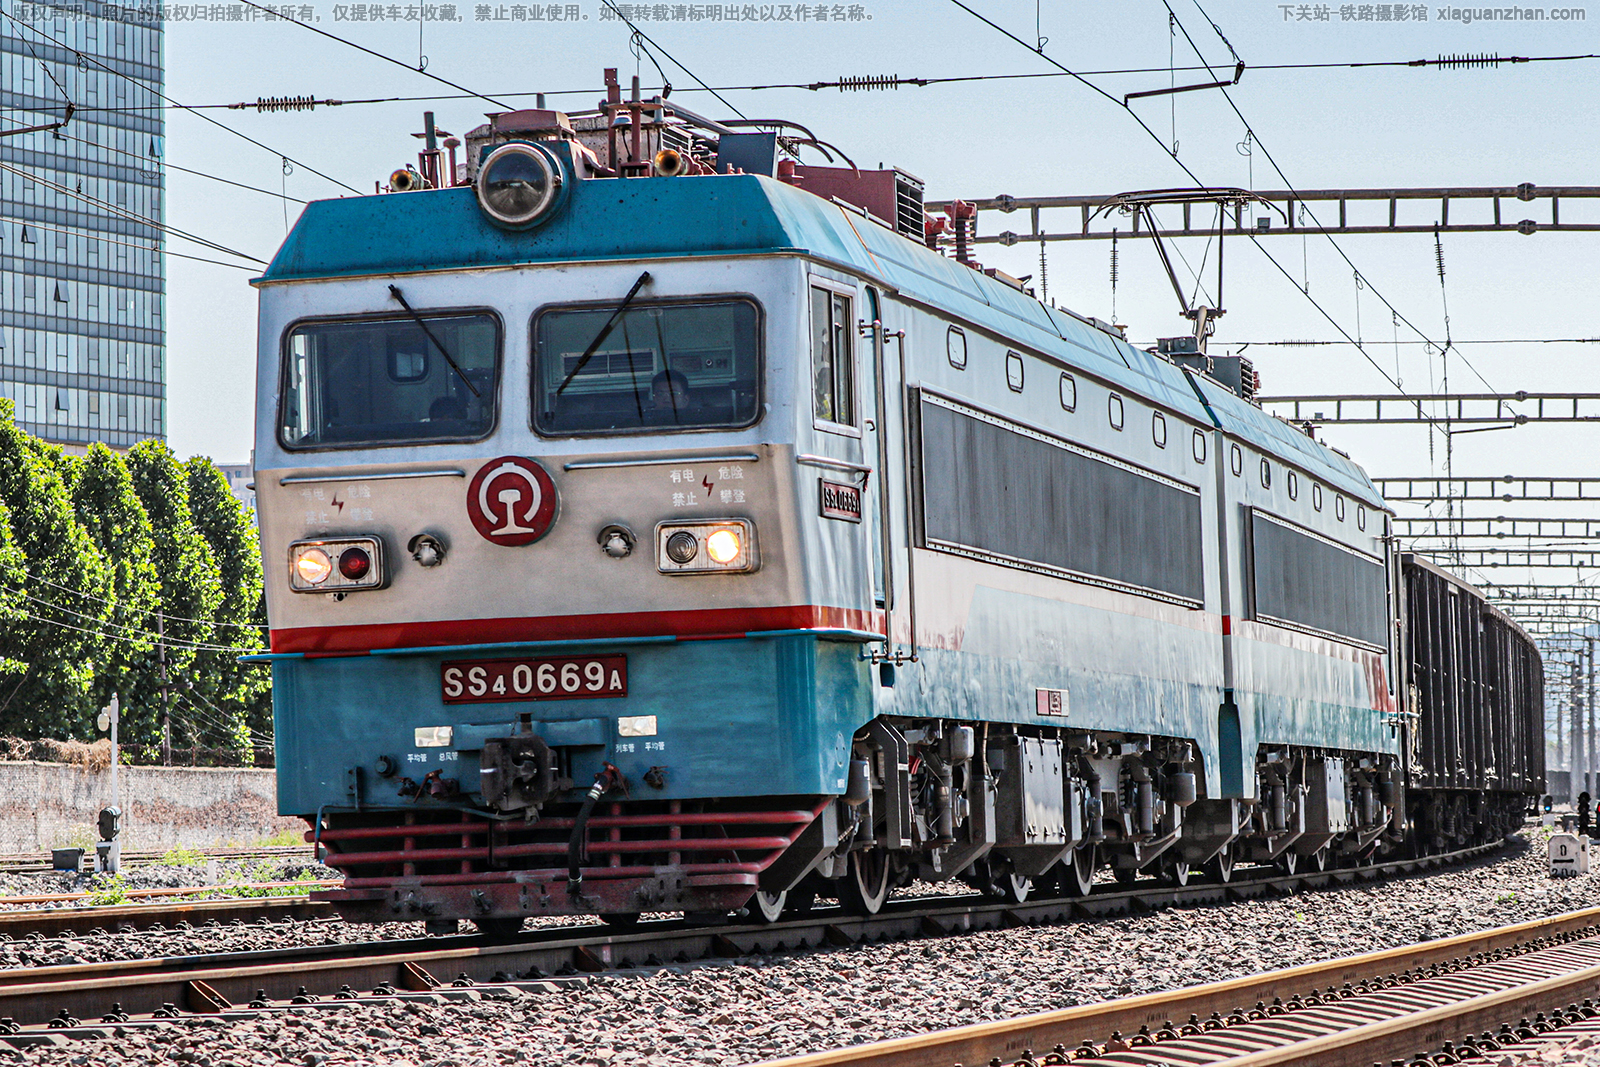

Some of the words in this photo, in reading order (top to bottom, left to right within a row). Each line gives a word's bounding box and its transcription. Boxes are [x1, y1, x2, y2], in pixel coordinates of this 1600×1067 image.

[669, 469, 695, 483] 有电
[718, 465, 744, 480] 危险
[672, 491, 698, 507] 禁止
